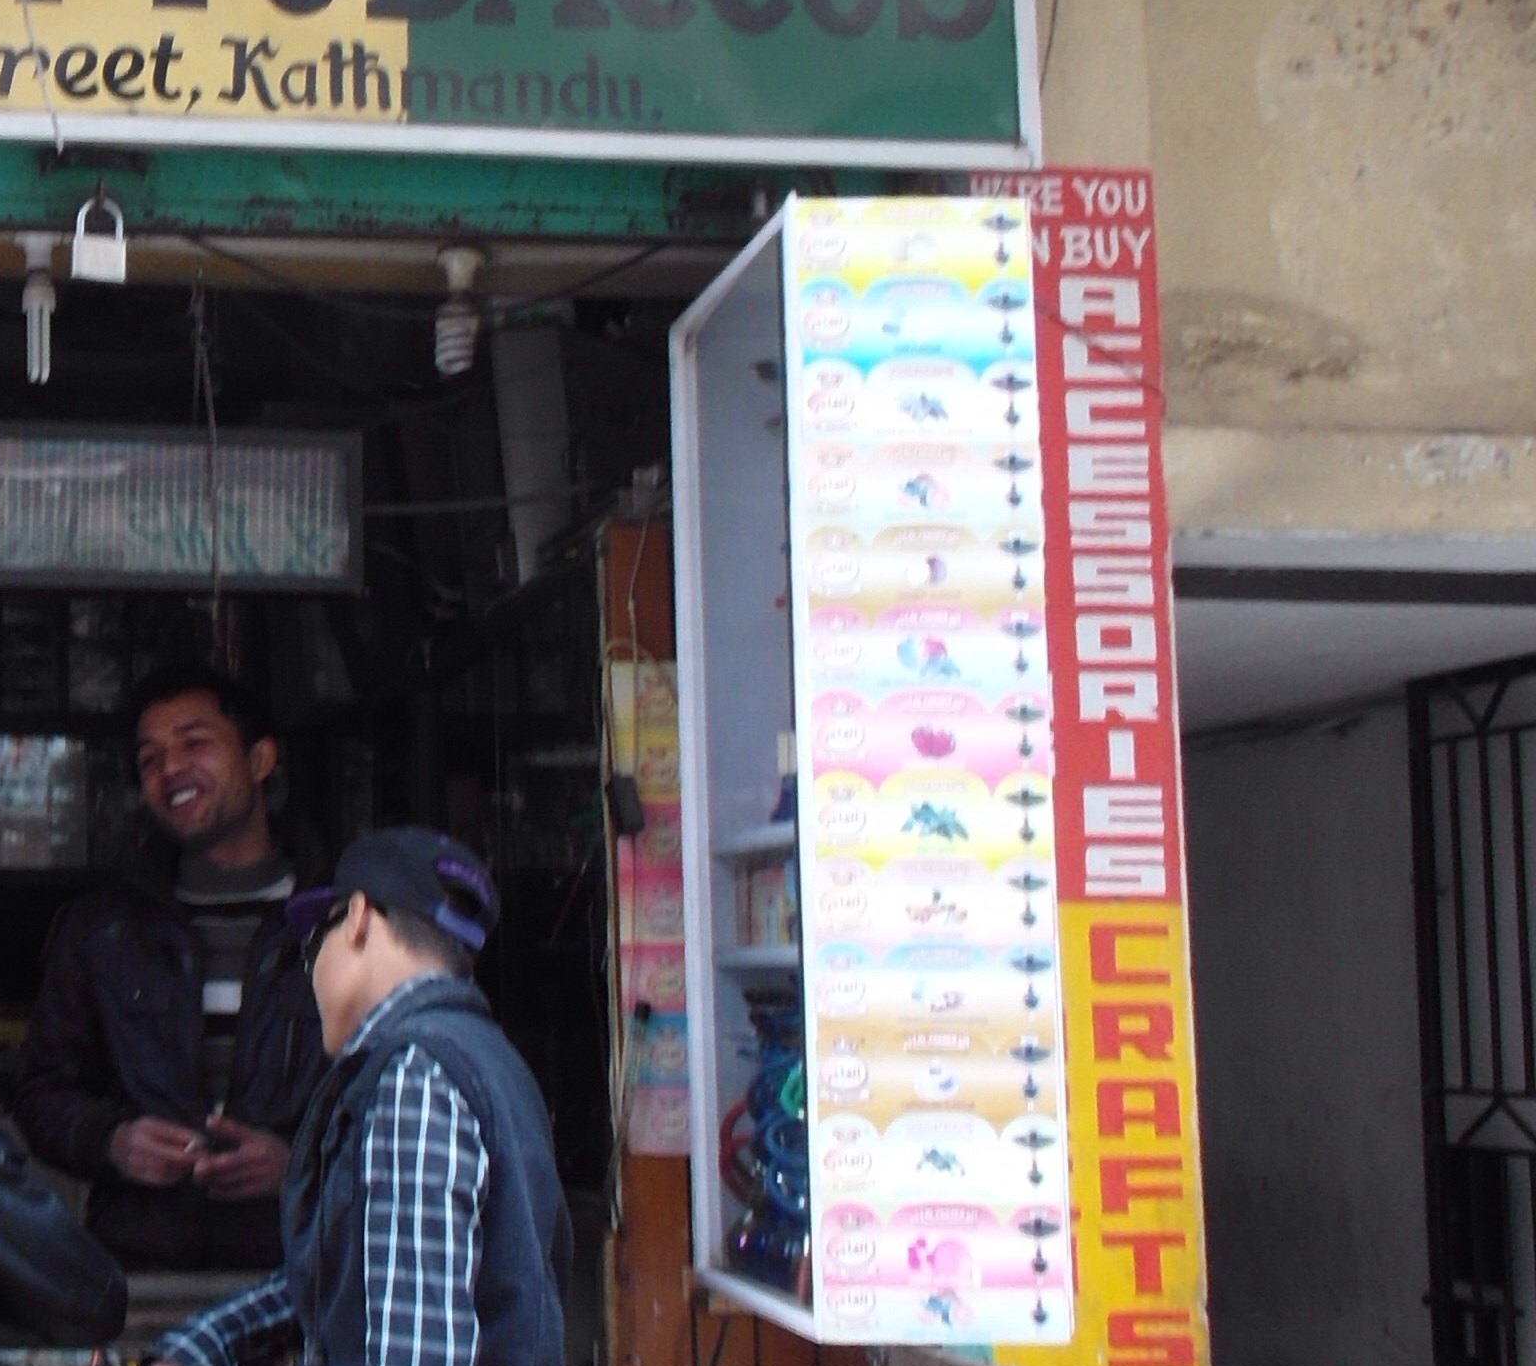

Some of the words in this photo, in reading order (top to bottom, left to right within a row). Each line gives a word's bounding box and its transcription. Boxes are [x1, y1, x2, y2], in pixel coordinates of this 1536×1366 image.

[216, 34, 665, 125] Kathmandu.
[1071, 175, 1148, 219] YOU
[1058, 223, 1153, 272] BUY
[1058, 275, 1167, 898] ACCESSORIES
